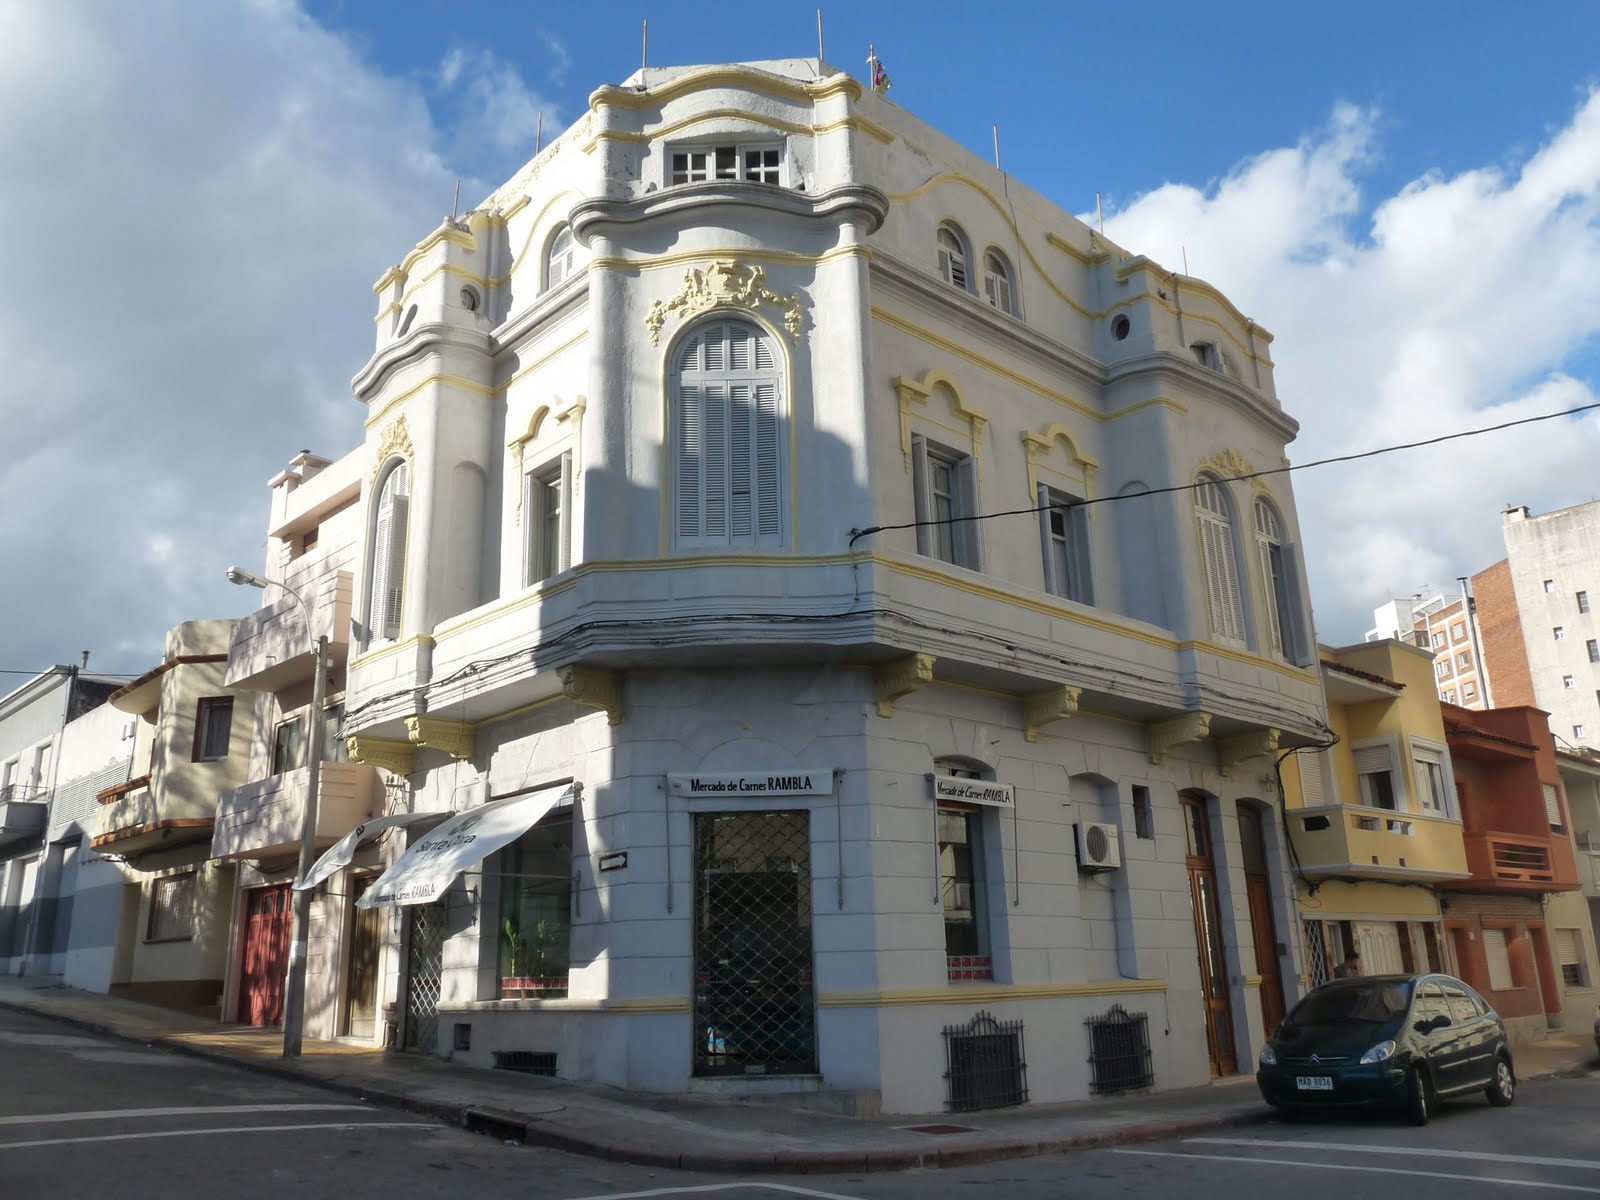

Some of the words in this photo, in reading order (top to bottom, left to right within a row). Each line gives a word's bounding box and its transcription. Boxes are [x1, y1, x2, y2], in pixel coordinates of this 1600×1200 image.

[691, 779, 726, 792] Mercado
[727, 780, 738, 791] de
[739, 778, 767, 791] Carnes
[768, 777, 812, 790] RAMBLA
[957, 787, 965, 797] de
[965, 786, 982, 799] Carnes
[983, 788, 1011, 803] RAMBLA
